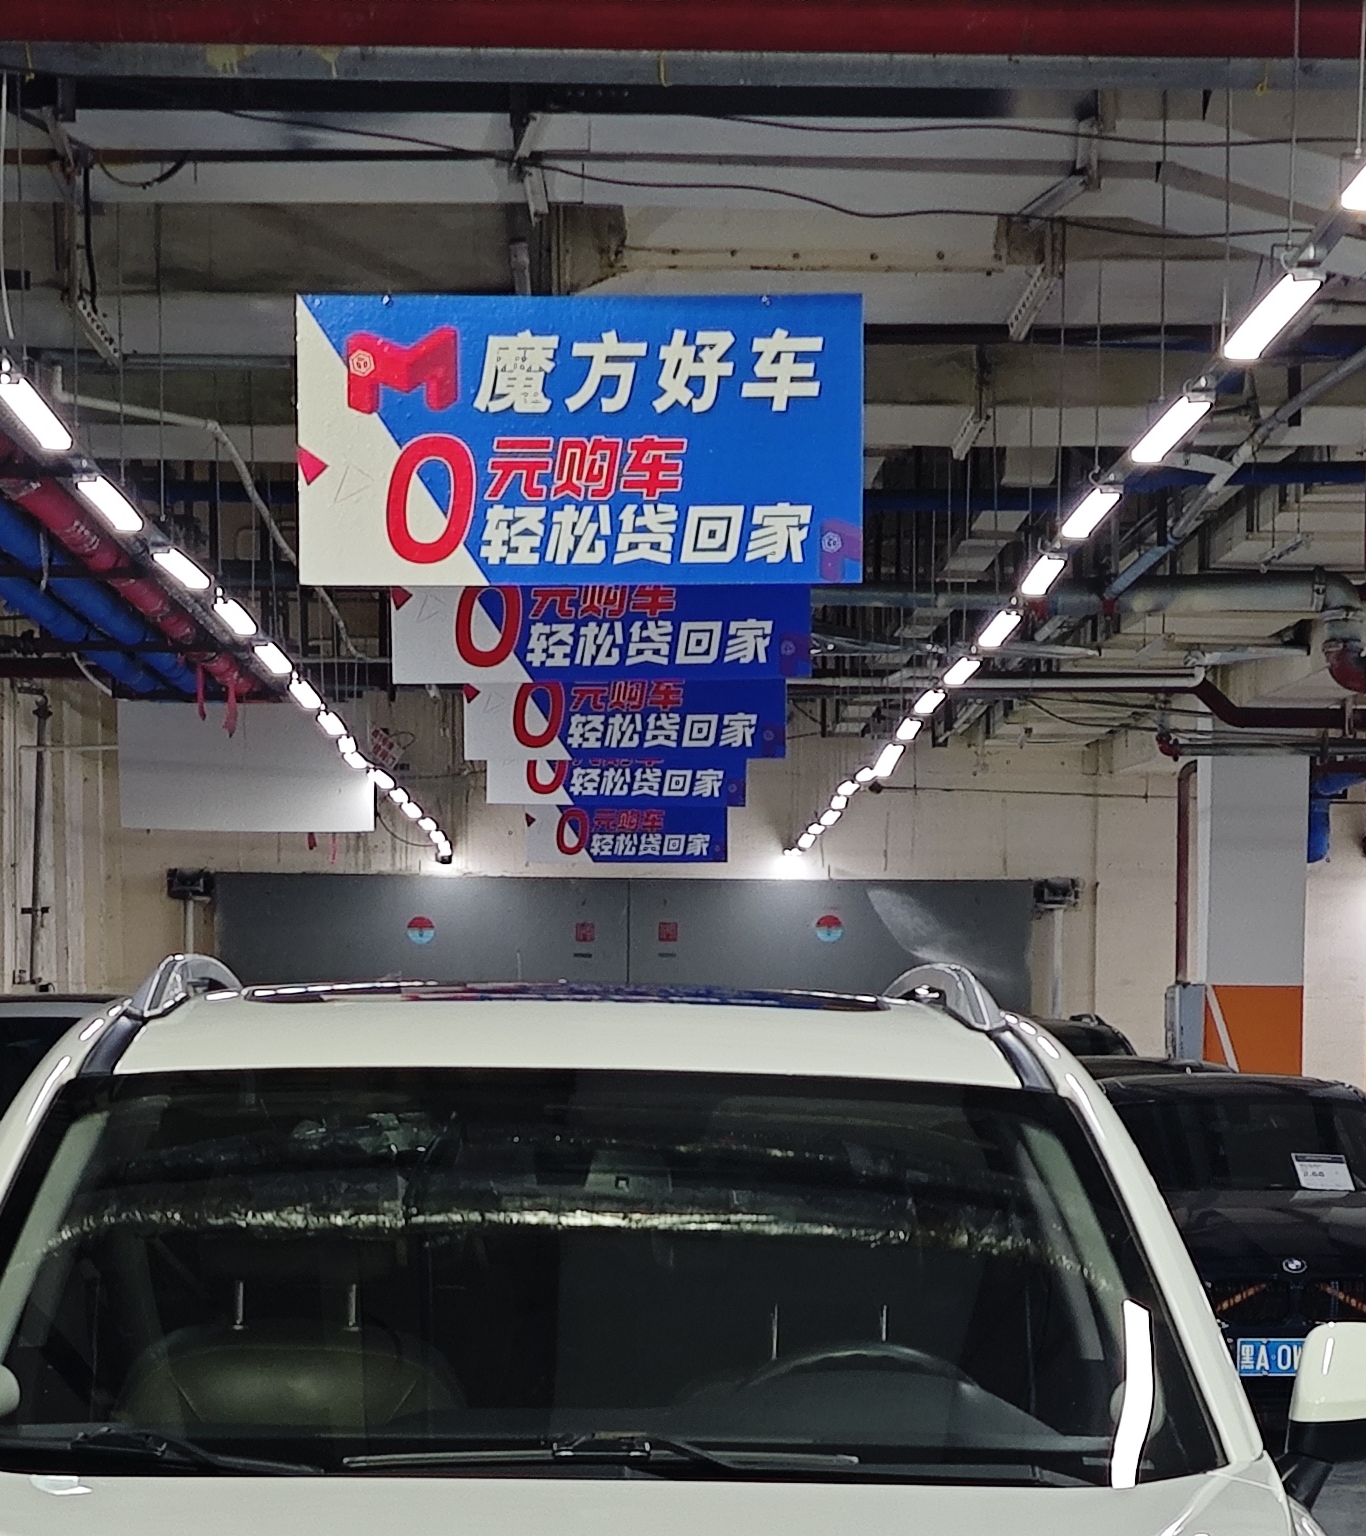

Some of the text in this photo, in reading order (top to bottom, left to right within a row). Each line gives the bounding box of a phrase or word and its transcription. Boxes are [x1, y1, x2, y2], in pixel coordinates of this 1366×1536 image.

[473, 328, 824, 413] 魔方好车
[485, 436, 687, 501] 元购车
[480, 503, 812, 565] 轻松贷回家
[526, 619, 773, 666] 轻松贷回家
[566, 713, 757, 748] 轻松贷回家
[570, 768, 724, 797] 轻松贷回家
[589, 834, 710, 856] 轻松贷回家
